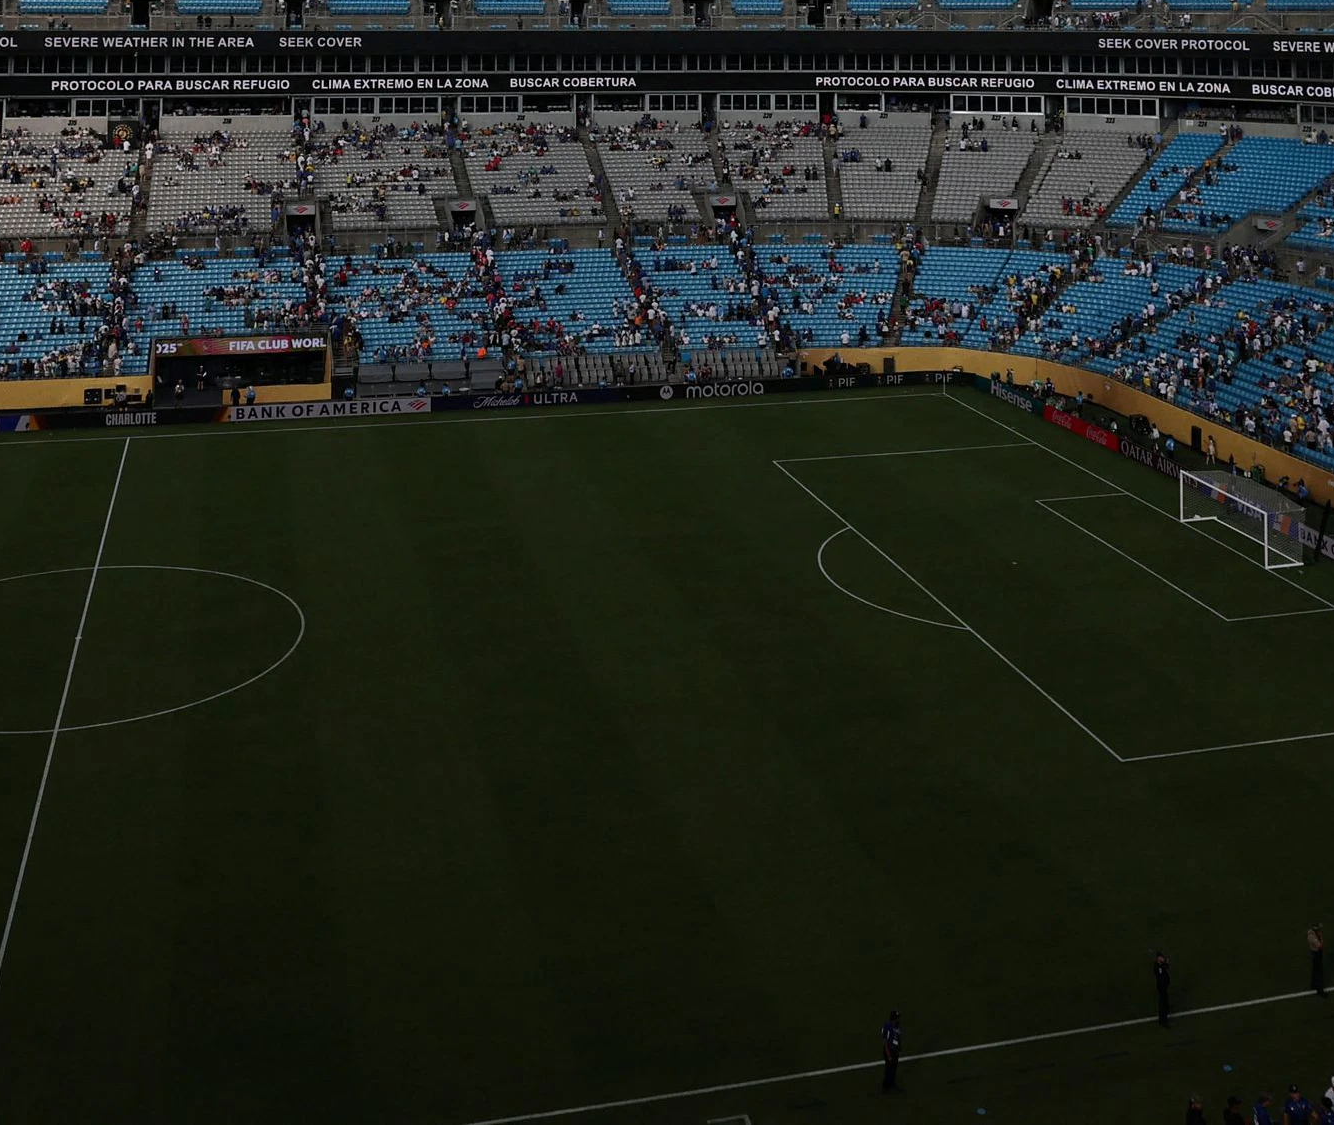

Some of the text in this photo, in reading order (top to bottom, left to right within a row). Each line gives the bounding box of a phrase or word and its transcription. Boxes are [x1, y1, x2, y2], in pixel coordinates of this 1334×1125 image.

[44, 37, 99, 48] SEVERE
[102, 37, 168, 48] WEATHER
[172, 37, 185, 48] IN
[188, 37, 215, 48] THE
[217, 37, 255, 48] AREA
[279, 37, 314, 48] SEEK
[317, 36, 362, 48] COVER
[1098, 38, 1132, 49] SEEK
[1134, 38, 1178, 50] COVER
[1181, 39, 1251, 51] PROTOCOL
[1272, 40, 1321, 53] SEVERE
[51, 77, 637, 91] PROTOCOLO PARA BUSCAR REFUGIO CLIMA EXTREMO EN LA ZONA BUSCAR COBERTURA
[815, 76, 890, 87] PROTOCOLO
[893, 77, 926, 87] PARA
[928, 77, 978, 88] BUSCAR
[981, 77, 1035, 89] REFUGIO
[1056, 78, 1095, 90] CLIMA
[1096, 79, 1156, 91] EXTREMO
[1159, 81, 1176, 92] EN
[1179, 81, 1195, 92] LA
[1196, 82, 1231, 94] ZONA
[1251, 84, 1304, 97] BUSCAR
[229, 340, 255, 352] FIFA
[258, 339, 289, 351] CLUB
[685, 381, 765, 399] motorola
[838, 377, 856, 388] PIF
[473, 392, 579, 410] Michelob ULTRA
[990, 378, 1033, 414] Hisense
[236, 400, 402, 421] BANK OF AMERICA
[105, 412, 157, 426] CHARLOTTE
[1120, 440, 1153, 467] QATAR
